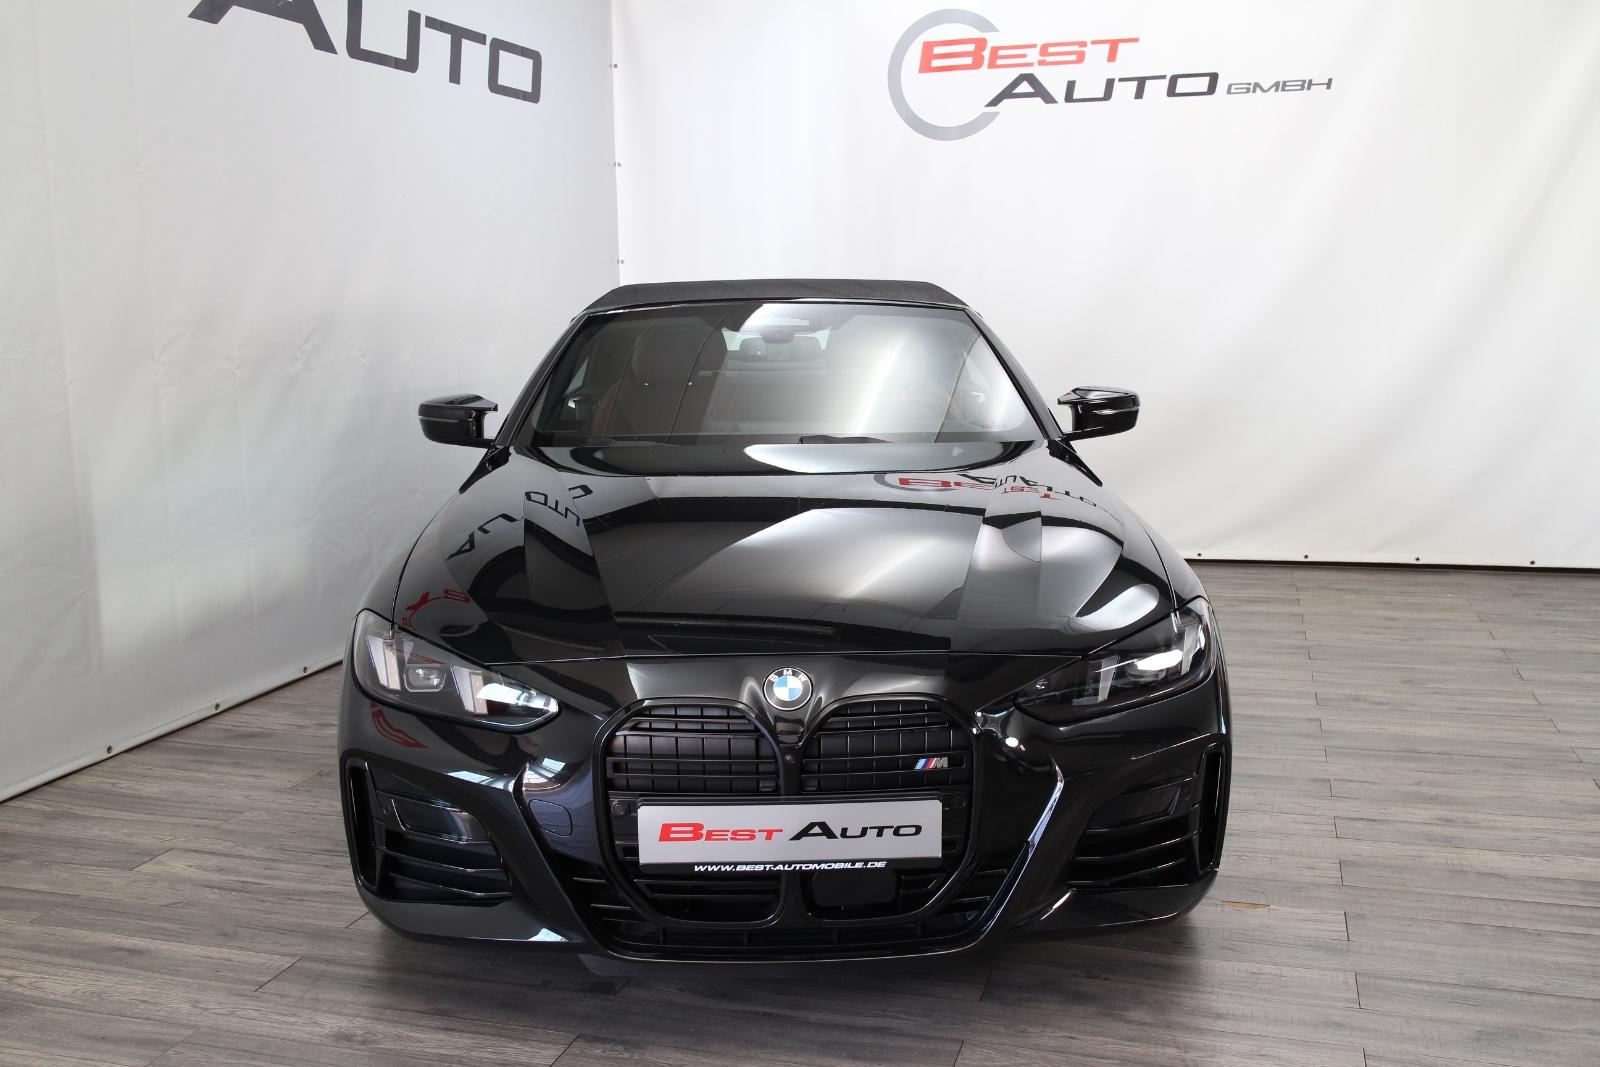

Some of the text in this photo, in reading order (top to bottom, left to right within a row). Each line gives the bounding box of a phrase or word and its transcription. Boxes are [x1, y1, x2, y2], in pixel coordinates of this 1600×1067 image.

[919, 38, 1139, 74] BEST
[985, 72, 1334, 108] AUTO GMBH
[769, 669, 808, 682] BMW
[658, 821, 923, 844] BEST AUTO
[693, 861, 888, 873] WWW.BEST-AUTOMOBILE.DE
